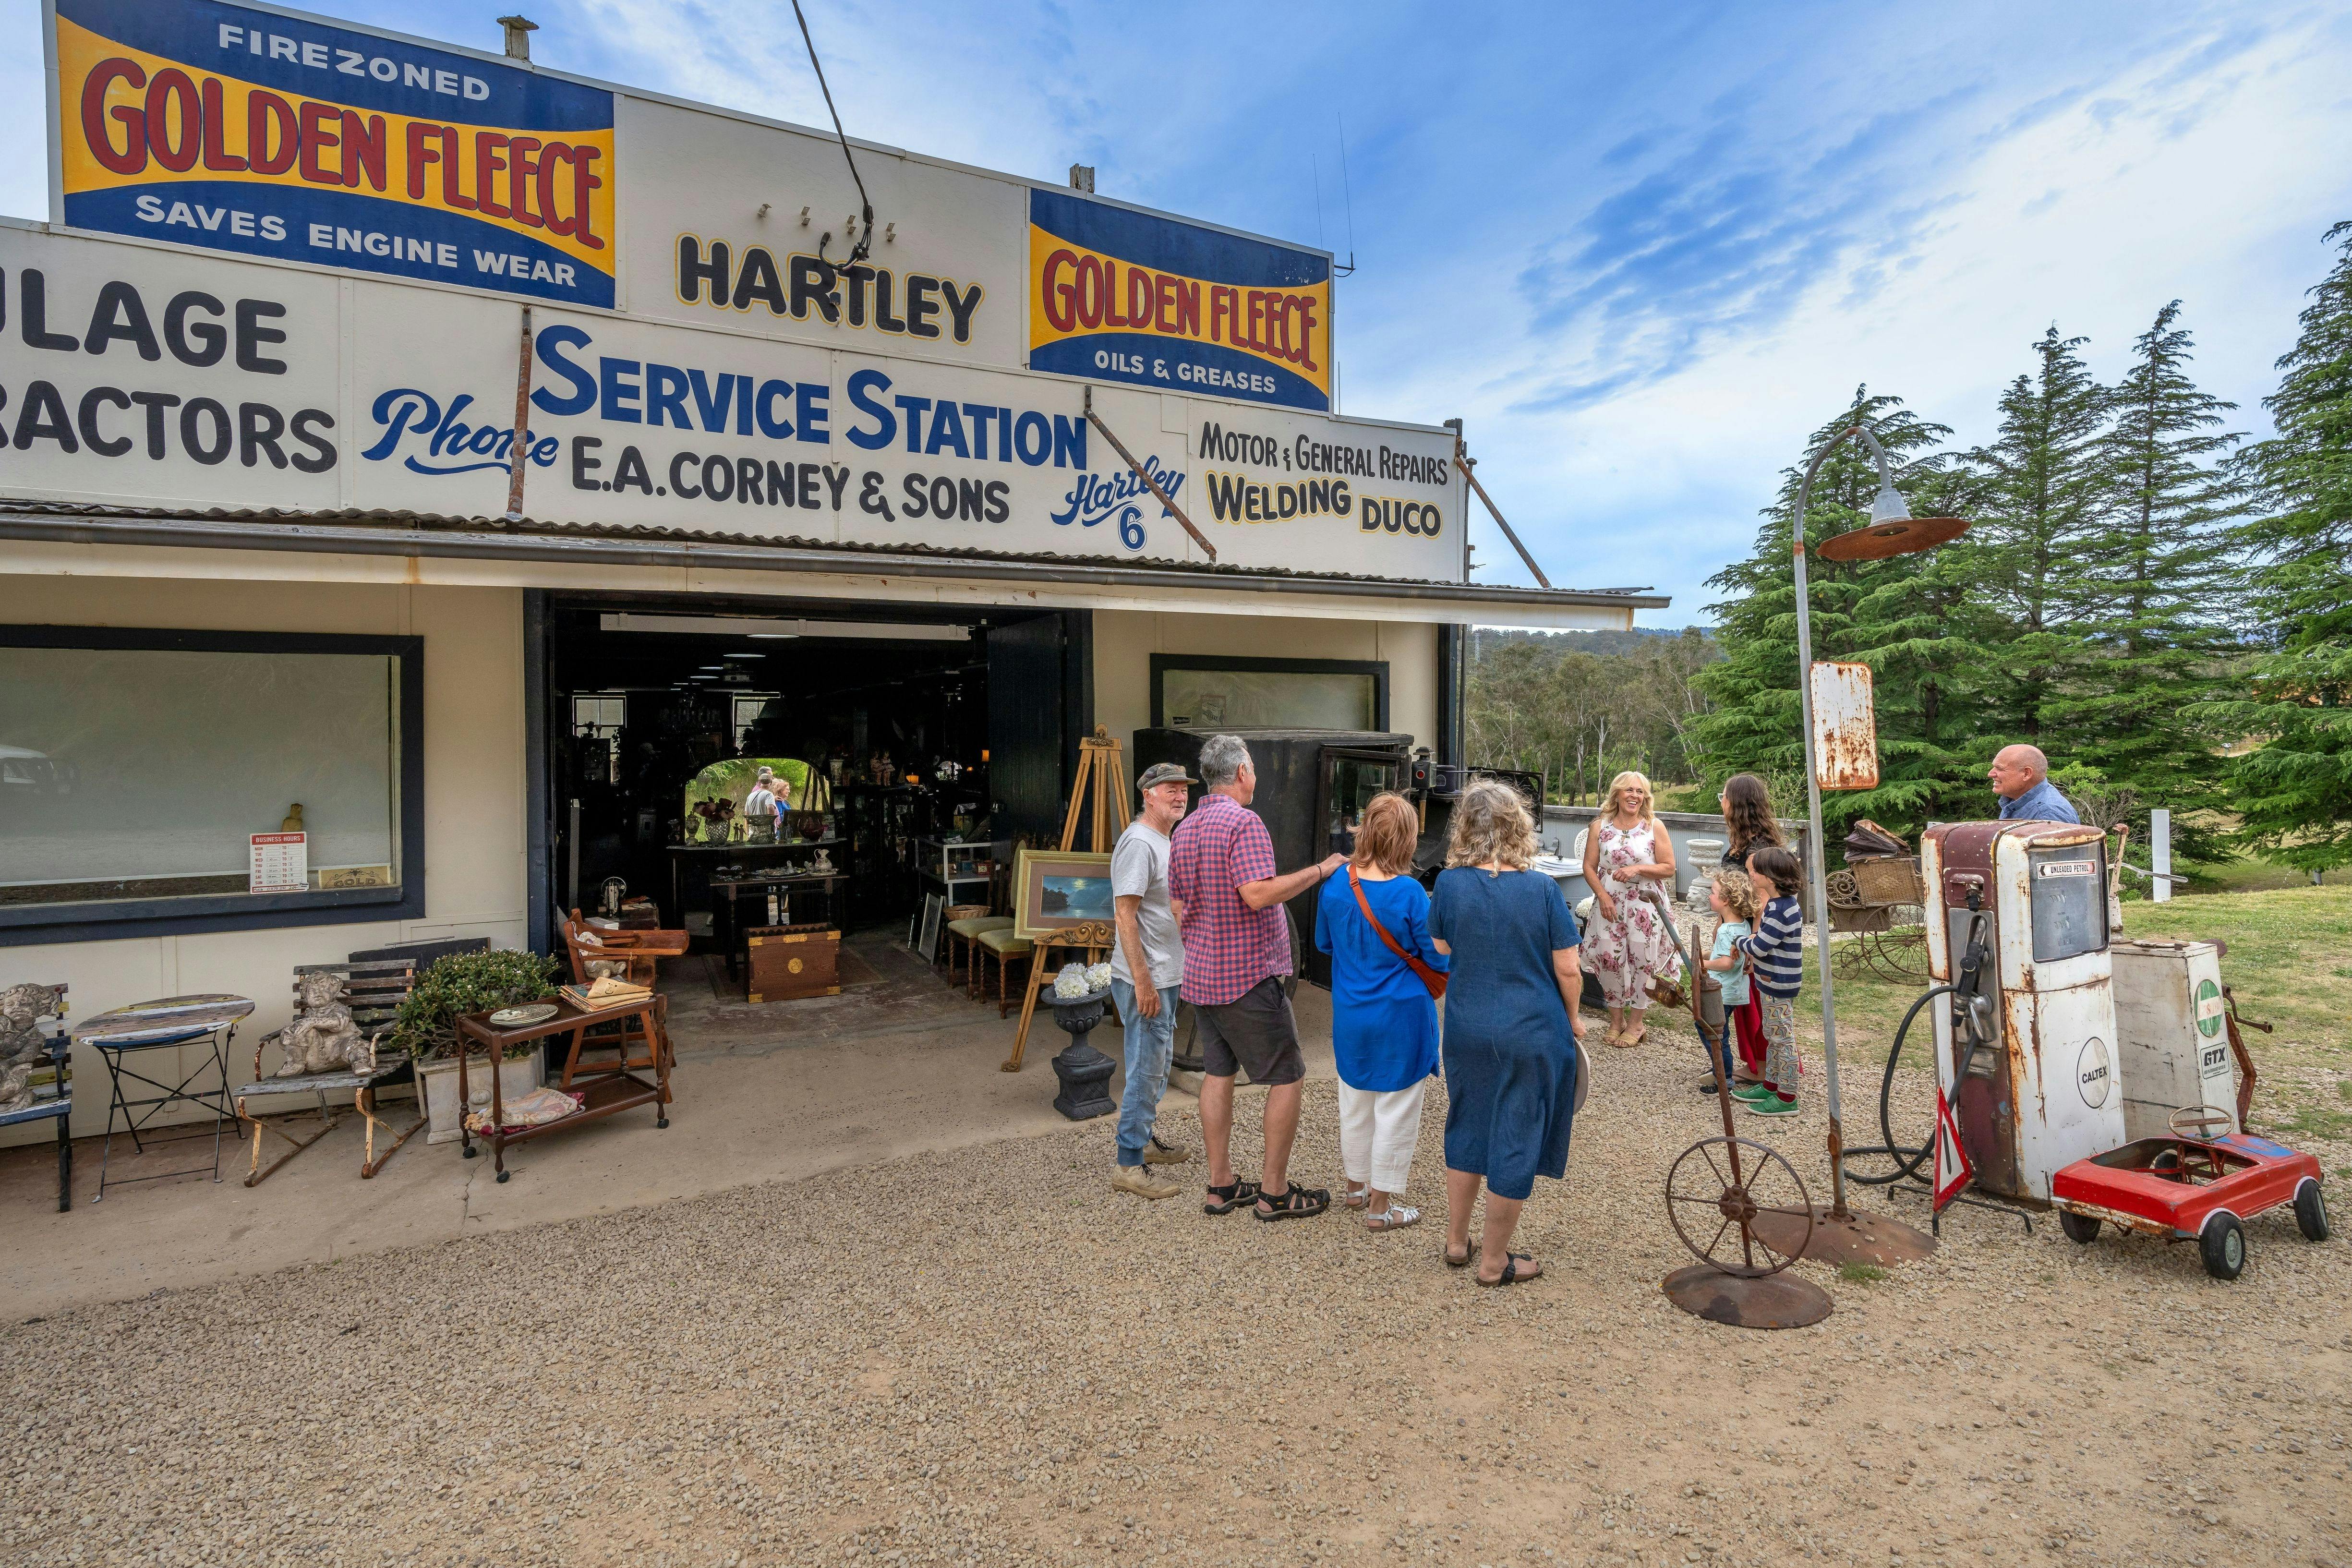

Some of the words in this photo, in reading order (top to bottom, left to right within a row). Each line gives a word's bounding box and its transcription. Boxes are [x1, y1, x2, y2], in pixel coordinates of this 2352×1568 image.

[219, 23, 490, 100] FIREZONED
[81, 57, 386, 192] GOLDEN
[406, 122, 603, 250] FLEECE
[135, 195, 287, 242] SAVES
[309, 223, 458, 269] ENGINE
[473, 249, 577, 287] WEAR
[0, 266, 288, 375] LAGE
[680, 236, 982, 342] HARTLEY
[1042, 249, 1200, 336] GOLDEN
[1210, 285, 1318, 372] FLEECE
[1095, 350, 1144, 374] OILS
[1153, 359, 1170, 380] &
[1177, 363, 1276, 394] GREASES
[0, 380, 338, 473] ACTORS
[361, 388, 560, 475] Phone
[859, 471, 896, 522] &
[902, 473, 1010, 524] SONS
[1050, 455, 1186, 527] Hartley
[1207, 472, 1351, 522] WELDING
[1362, 497, 1441, 536] DUCO
[1118, 505, 1147, 552] 6
[334, 878, 375, 887] GOLD
[2050, 865, 2072, 873] UNLEADED
[2082, 1065, 2108, 1084] CALTEX
[2204, 1047, 2226, 1066] GTX
